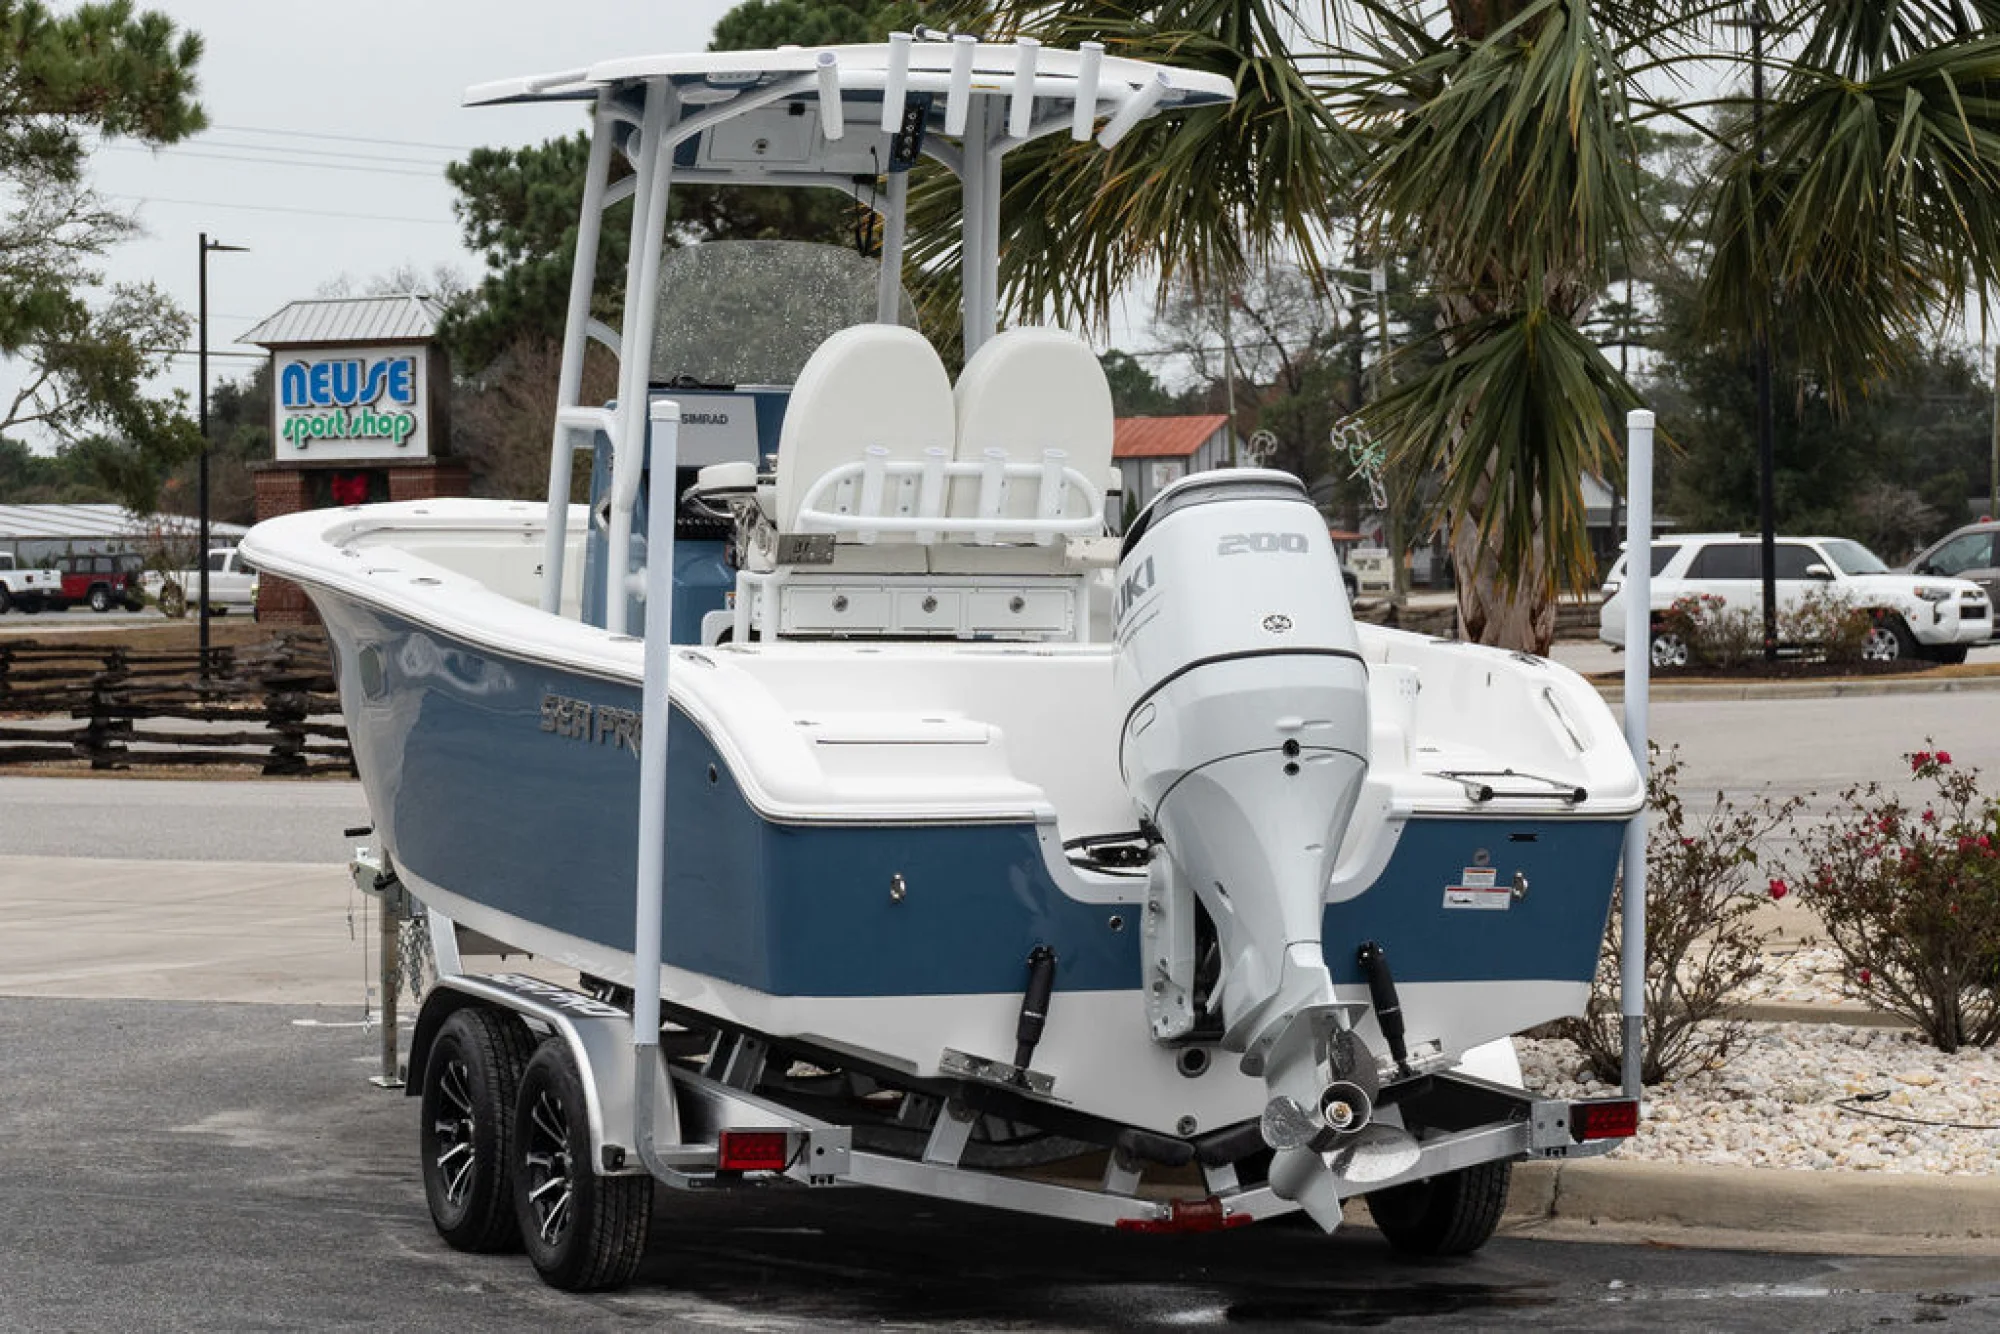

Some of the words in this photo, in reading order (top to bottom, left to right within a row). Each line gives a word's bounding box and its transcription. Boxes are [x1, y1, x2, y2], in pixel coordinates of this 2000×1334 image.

[281, 359, 410, 407] NEUSE
[282, 408, 346, 447] sport
[350, 407, 412, 444] shop
[680, 413, 729, 425] SIMRAD
[1217, 532, 1310, 555] 200
[1113, 554, 1156, 627] UKI
[540, 692, 592, 743] SEA
